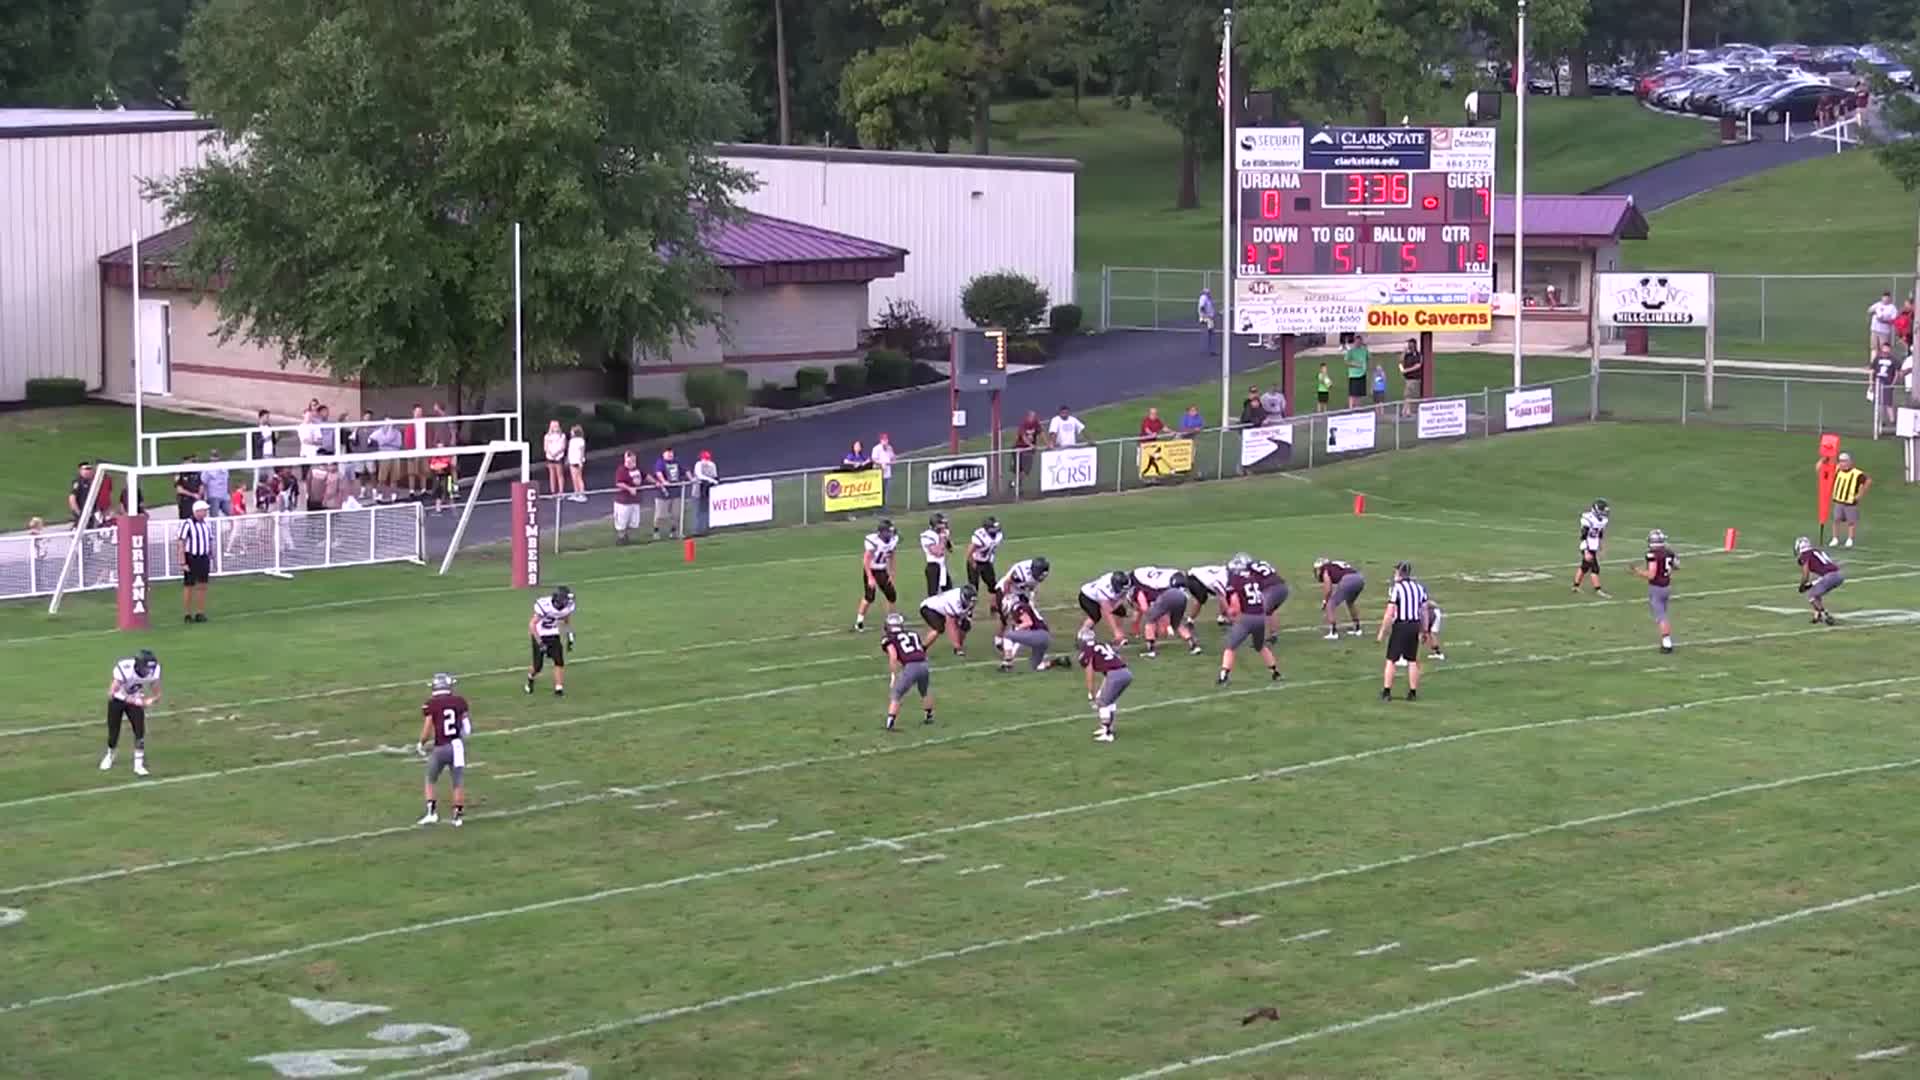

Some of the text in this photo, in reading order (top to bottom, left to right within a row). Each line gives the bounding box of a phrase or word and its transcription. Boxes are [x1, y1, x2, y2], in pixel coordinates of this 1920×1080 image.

[1242, 173, 1301, 189] URBANA
[1348, 174, 1407, 203] 3:36
[1447, 172, 1491, 189] GUEST
[1263, 190, 1279, 218] 0
[1475, 189, 1489, 217] 7
[1253, 226, 1299, 243] DOWN
[1312, 226, 1355, 243] TO GO
[1373, 226, 1426, 242] BALL ON
[1442, 226, 1470, 242] QTR
[1267, 243, 1284, 273] 2
[1334, 243, 1351, 272] 5
[1401, 243, 1418, 272] 5
[1368, 310, 1489, 326] Ohio Caverns
[711, 495, 771, 512] WEIDMANN
[525, 489, 539, 585] CLIMBERS
[131, 535, 145, 613] URBANA
[897, 632, 923, 654] 27
[443, 708, 457, 736] 2
